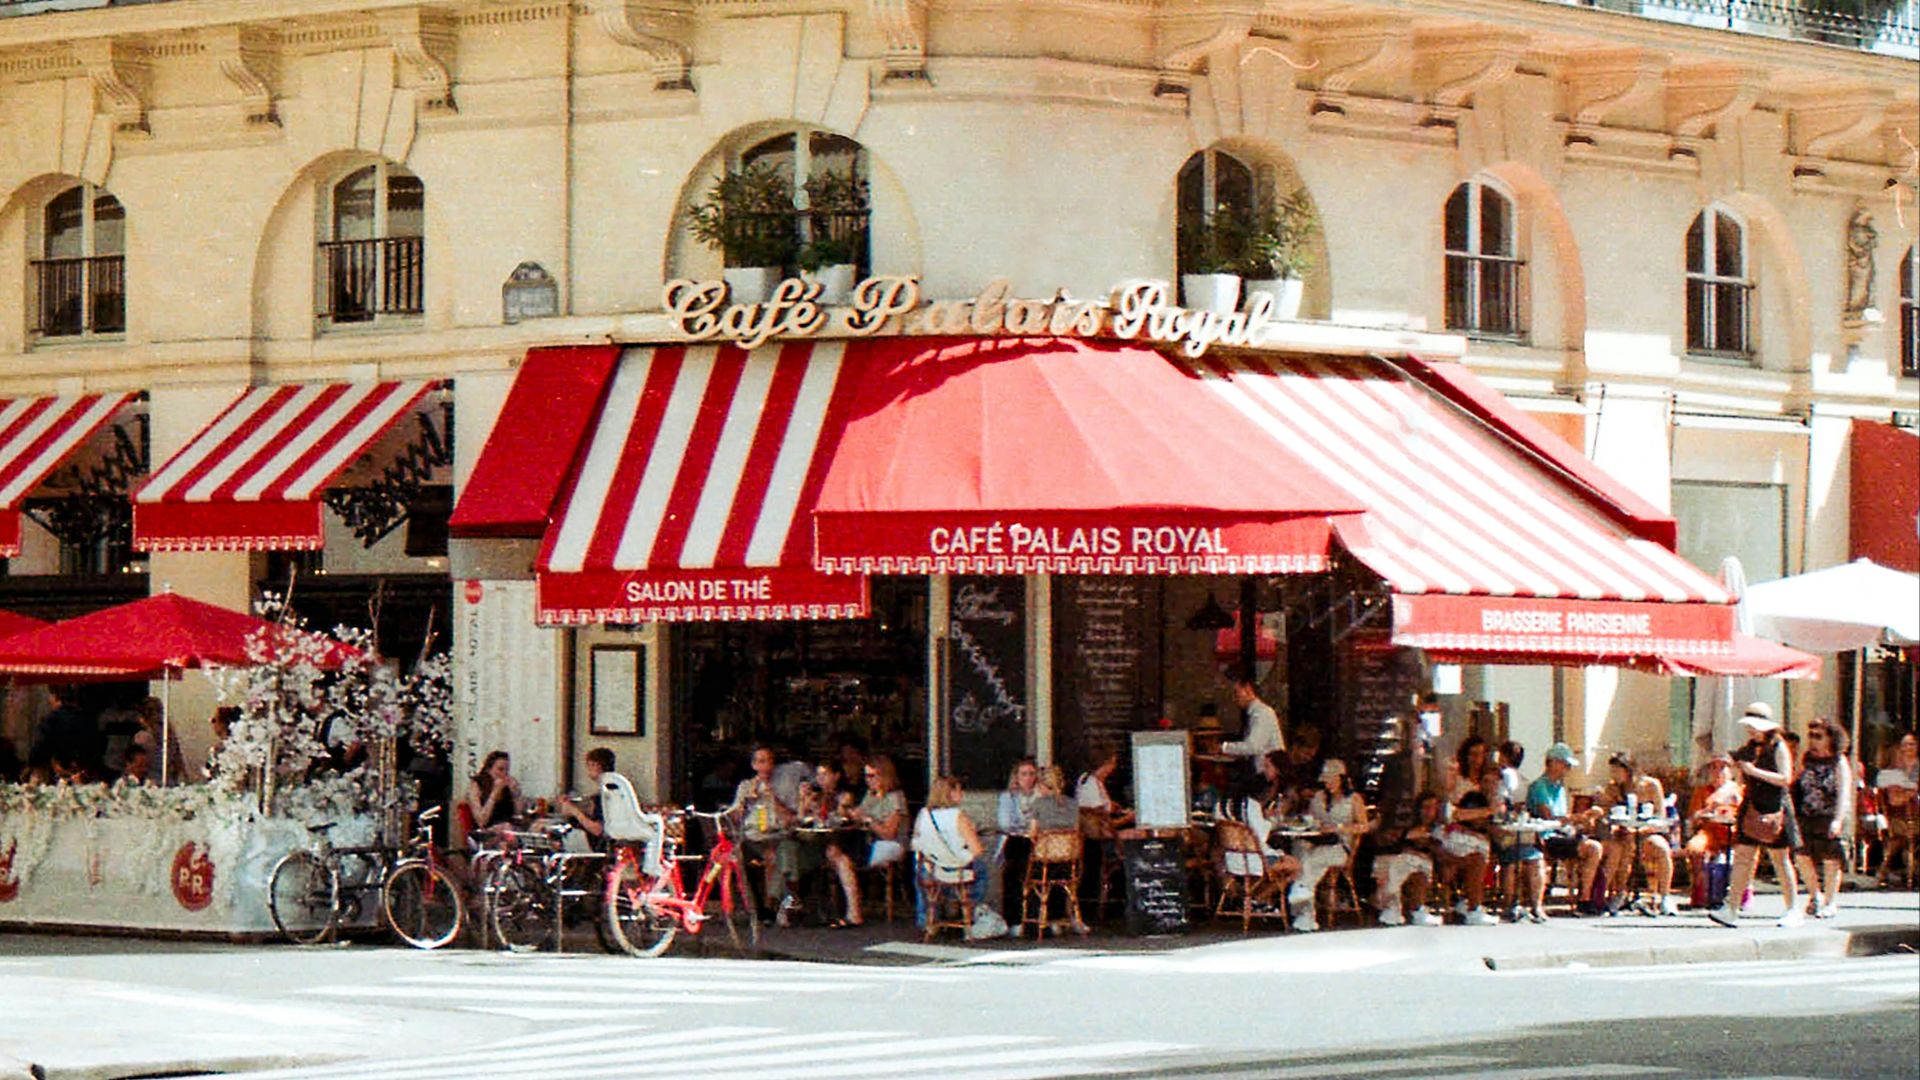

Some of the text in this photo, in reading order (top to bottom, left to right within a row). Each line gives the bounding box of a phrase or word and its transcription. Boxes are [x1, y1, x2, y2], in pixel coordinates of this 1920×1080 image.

[663, 275, 1274, 359] Café Palais Royal
[930, 521, 1229, 554] CAFÉ PALAIS ROYAL
[626, 575, 772, 602] SALON DE THÉ
[1481, 609, 1652, 635] BRASSERIE PARISIENNE
